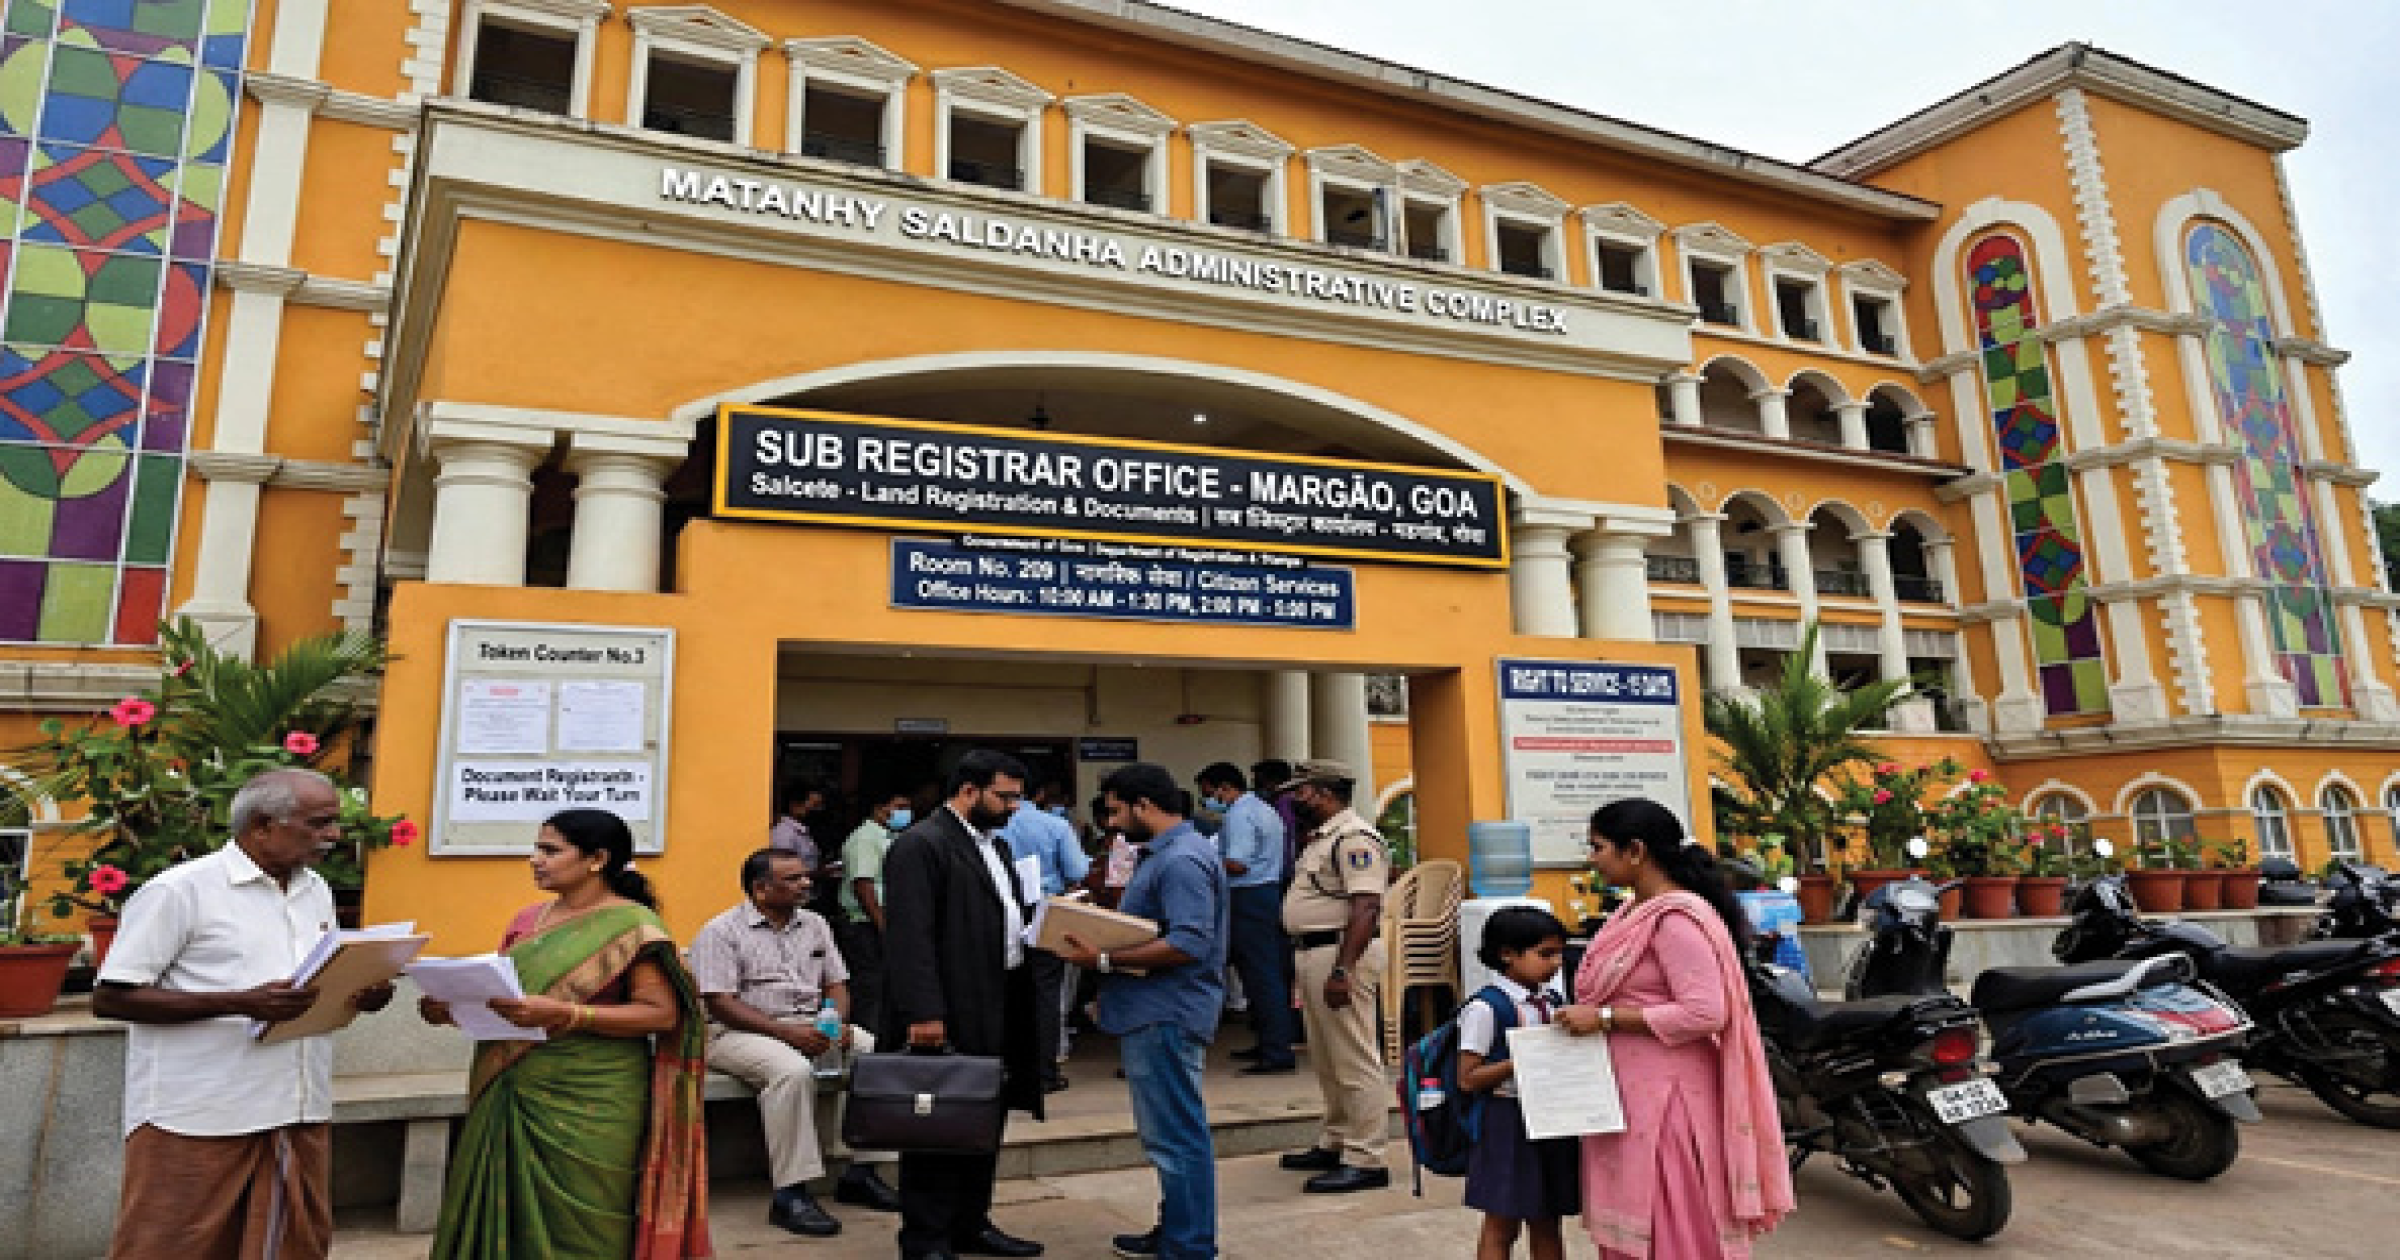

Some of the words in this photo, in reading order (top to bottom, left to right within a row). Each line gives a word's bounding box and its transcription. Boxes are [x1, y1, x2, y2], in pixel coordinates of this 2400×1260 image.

[659, 167, 886, 230] MATANHY
[900, 206, 1127, 269] SALDANHA
[1138, 245, 1416, 313] ADMINISTRATIVE
[1424, 289, 1568, 334] COMPLEX
[755, 429, 844, 469] SUB
[857, 436, 1083, 488] REGISTRAR
[1093, 457, 1221, 499] OFFICE
[1411, 485, 1479, 518] GOA
[751, 471, 842, 500] Salcete
[861, 481, 919, 505] Land
[926, 484, 1057, 514] Registration
[1061, 495, 1078, 515] &
[1083, 496, 1199, 524] Documents
[909, 551, 973, 575] Room
[977, 556, 1012, 578] No.
[1197, 569, 1261, 592] Citizen
[1264, 572, 1341, 597] Services
[917, 579, 972, 600] Office
[974, 584, 1034, 604] Hours:
[1086, 587, 1115, 607] AM
[1236, 597, 1262, 615] PM
[1310, 601, 1337, 619] PM
[479, 643, 531, 662] Token
[534, 643, 603, 663] Counter
[461, 768, 543, 784] Document
[463, 787, 519, 802] Please
[522, 787, 559, 802] Wait
[562, 787, 600, 803] Your
[603, 787, 641, 802] Turn
